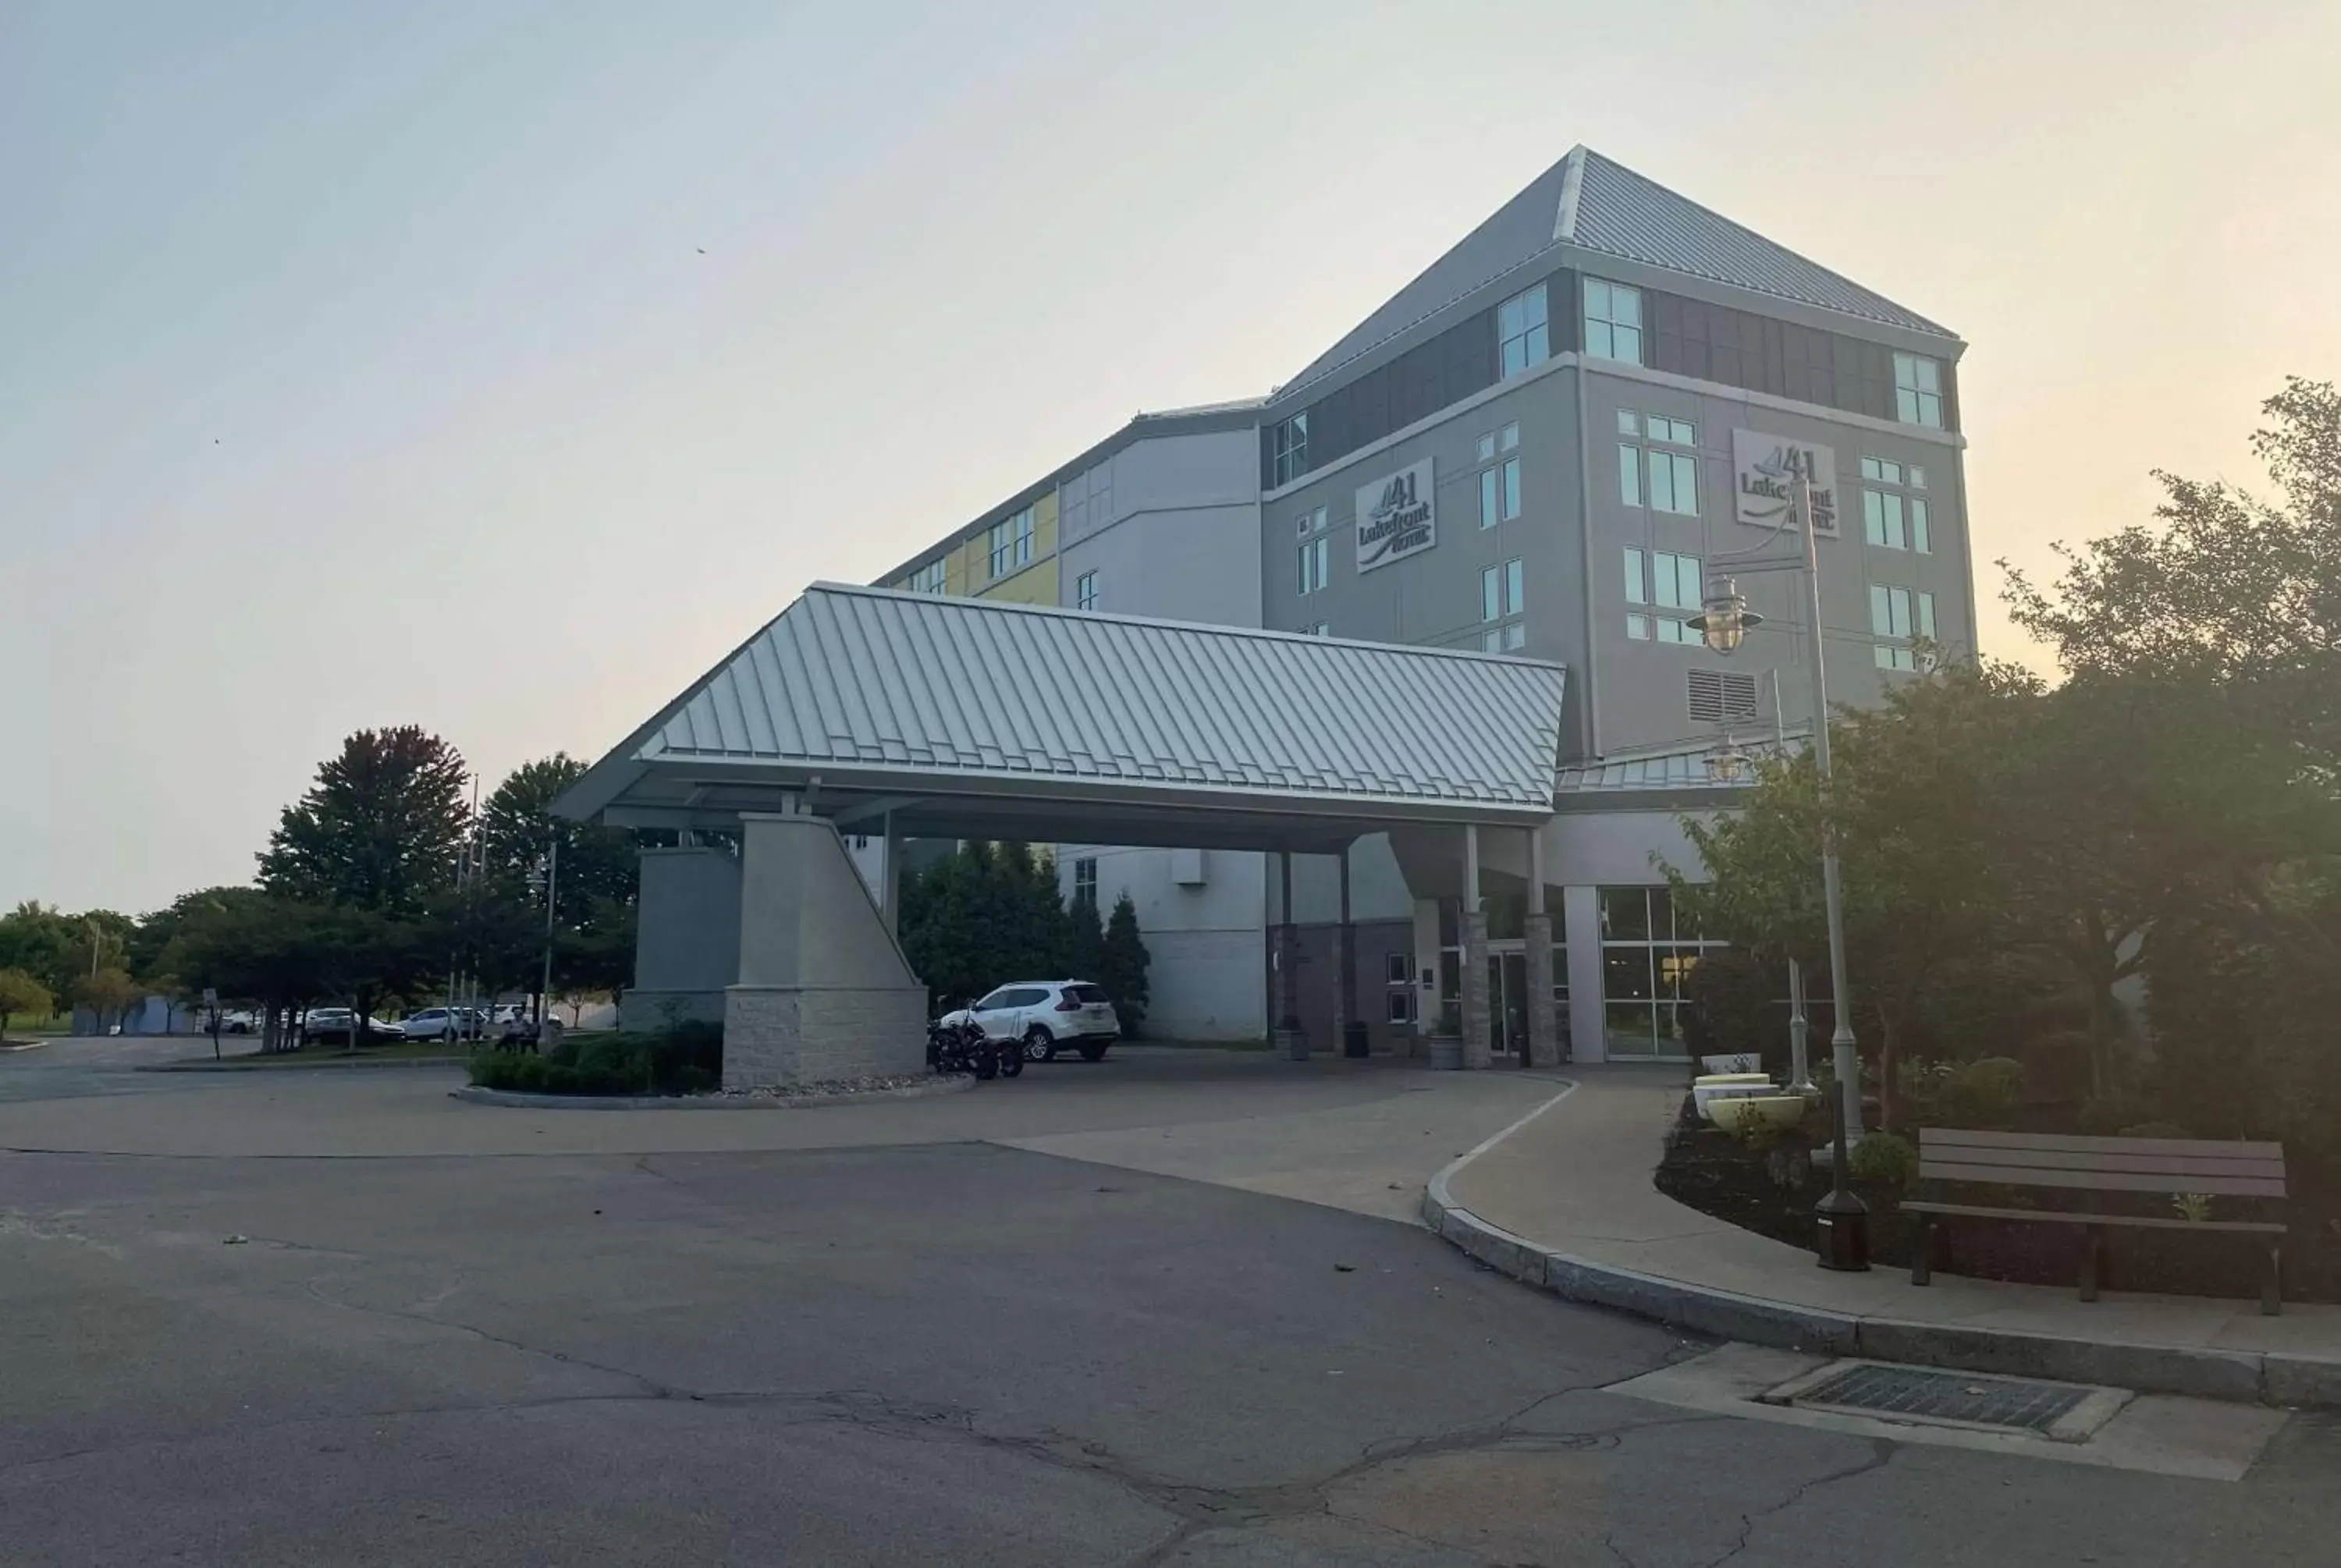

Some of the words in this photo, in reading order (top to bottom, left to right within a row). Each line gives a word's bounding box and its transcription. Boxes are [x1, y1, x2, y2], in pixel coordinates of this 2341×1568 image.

[1783, 445, 1818, 484] 41
[1391, 471, 1418, 509] 41
[1740, 472, 1834, 509] Lakent
[1359, 501, 1431, 546] Lakefront
[1789, 508, 1835, 531] HTEL
